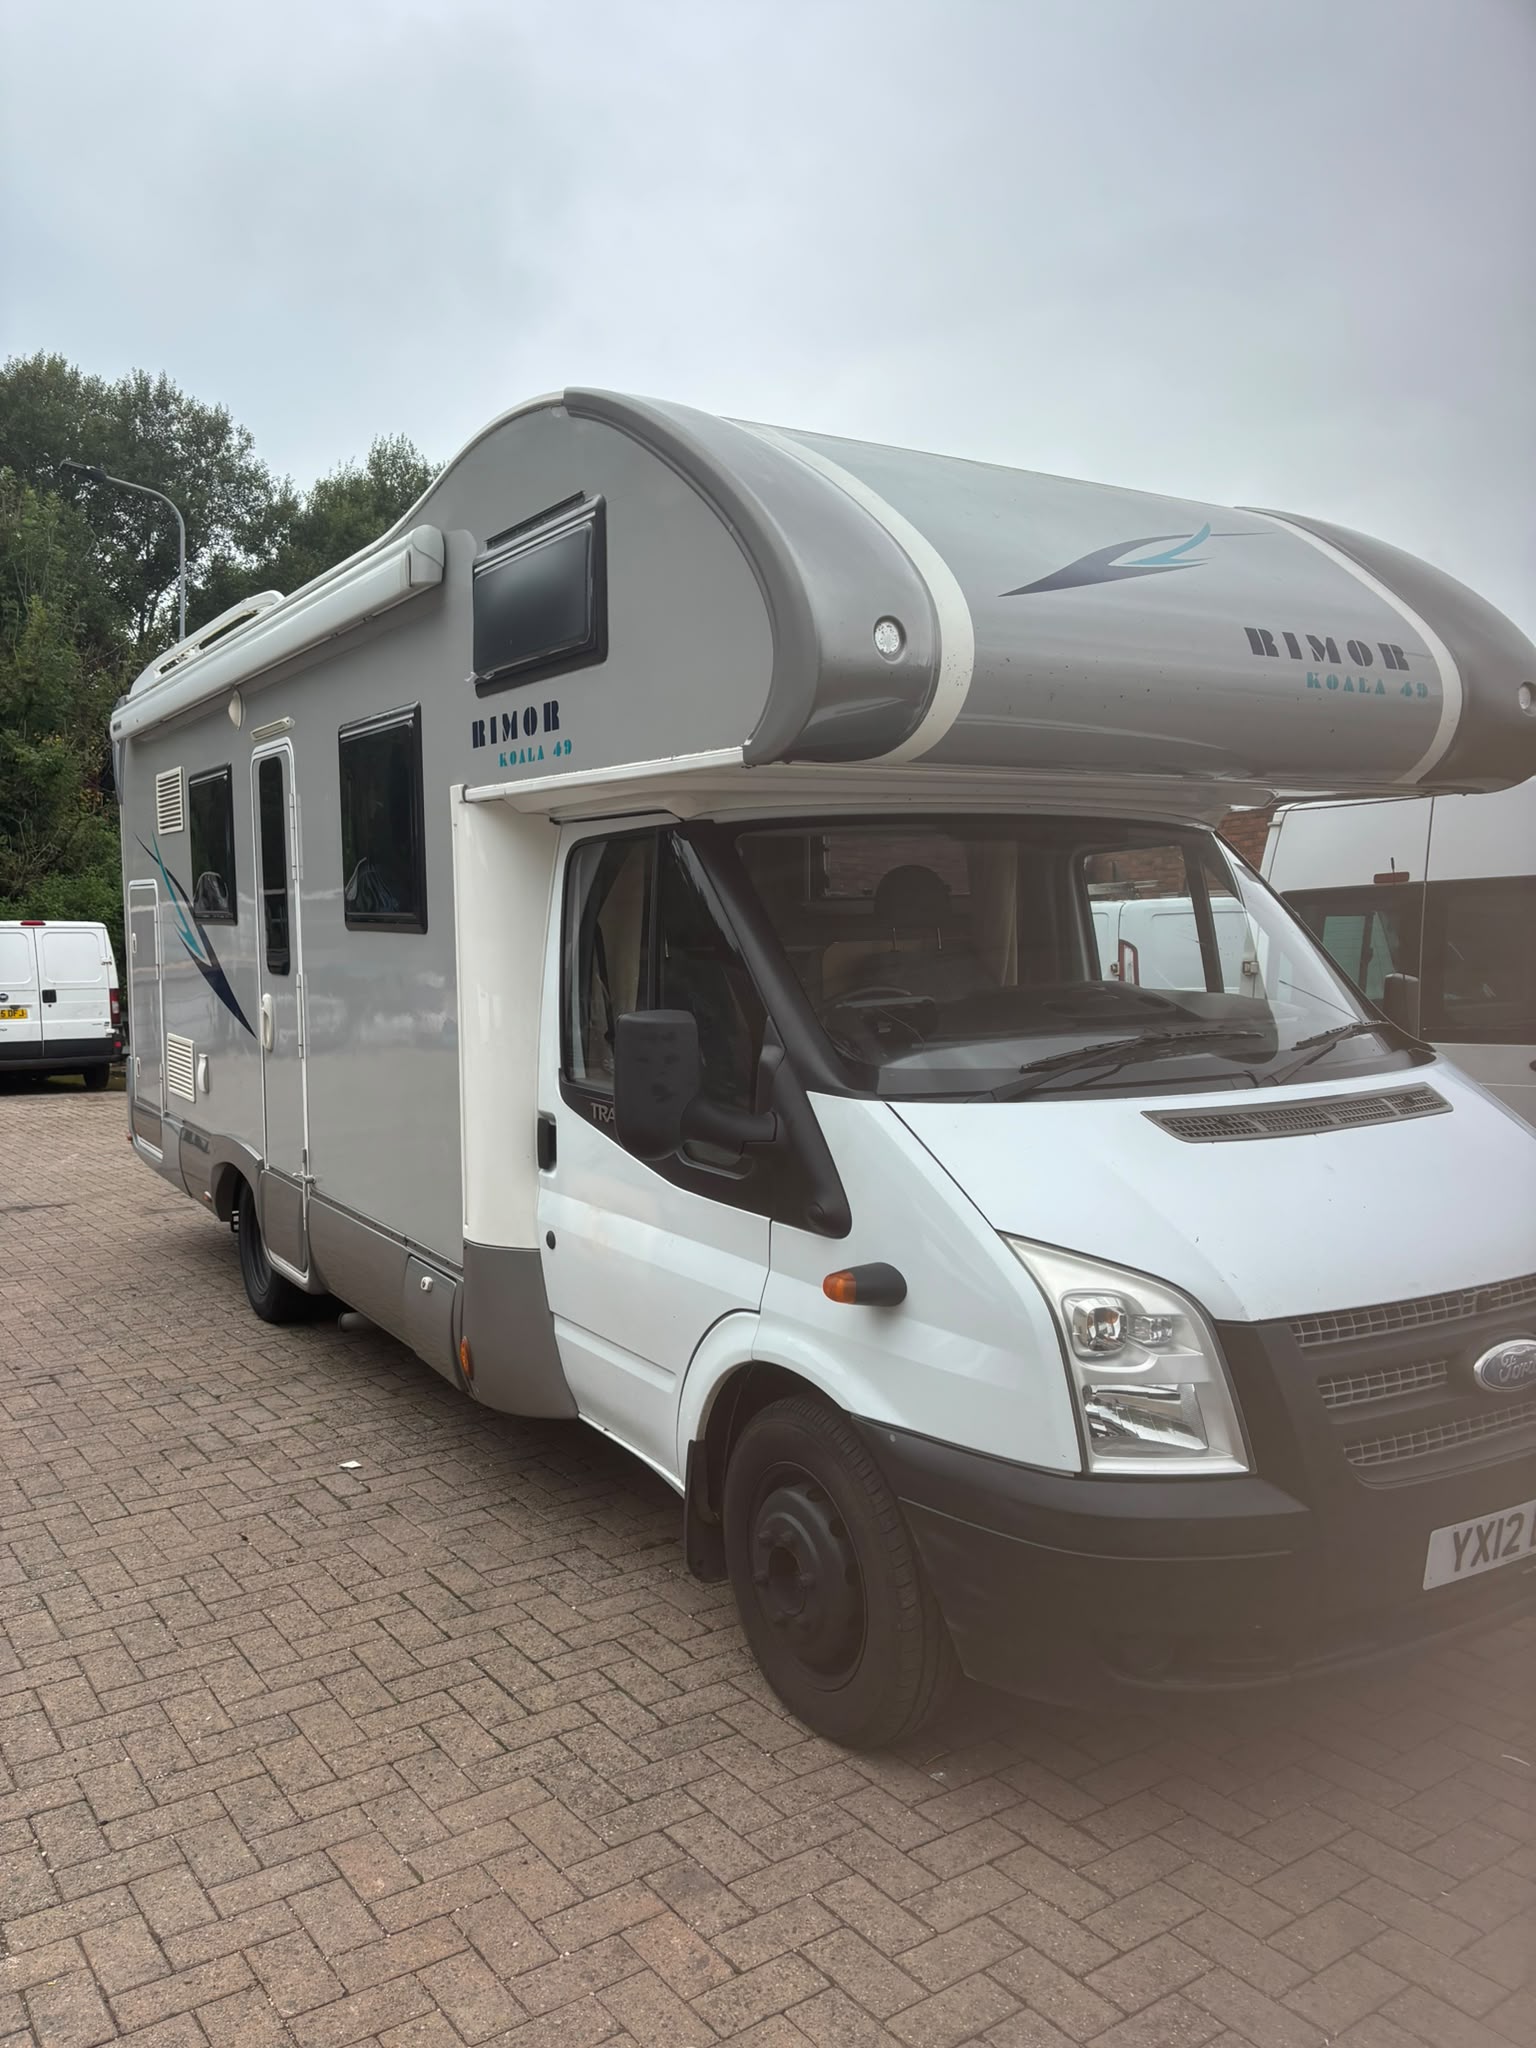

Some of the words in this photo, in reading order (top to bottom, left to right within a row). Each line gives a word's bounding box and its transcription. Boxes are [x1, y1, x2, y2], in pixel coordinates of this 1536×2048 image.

[1243, 626, 1410, 671] RIMOR
[1305, 671, 1386, 695] KOALA
[1400, 681, 1429, 699] 49
[472, 700, 560, 749] RIMOR
[499, 745, 545, 767] KOALA
[553, 738, 573, 757] 49
[590, 1102, 616, 1122] TRA
[1499, 1346, 1536, 1382] For
[1453, 1511, 1525, 1573] YX12
